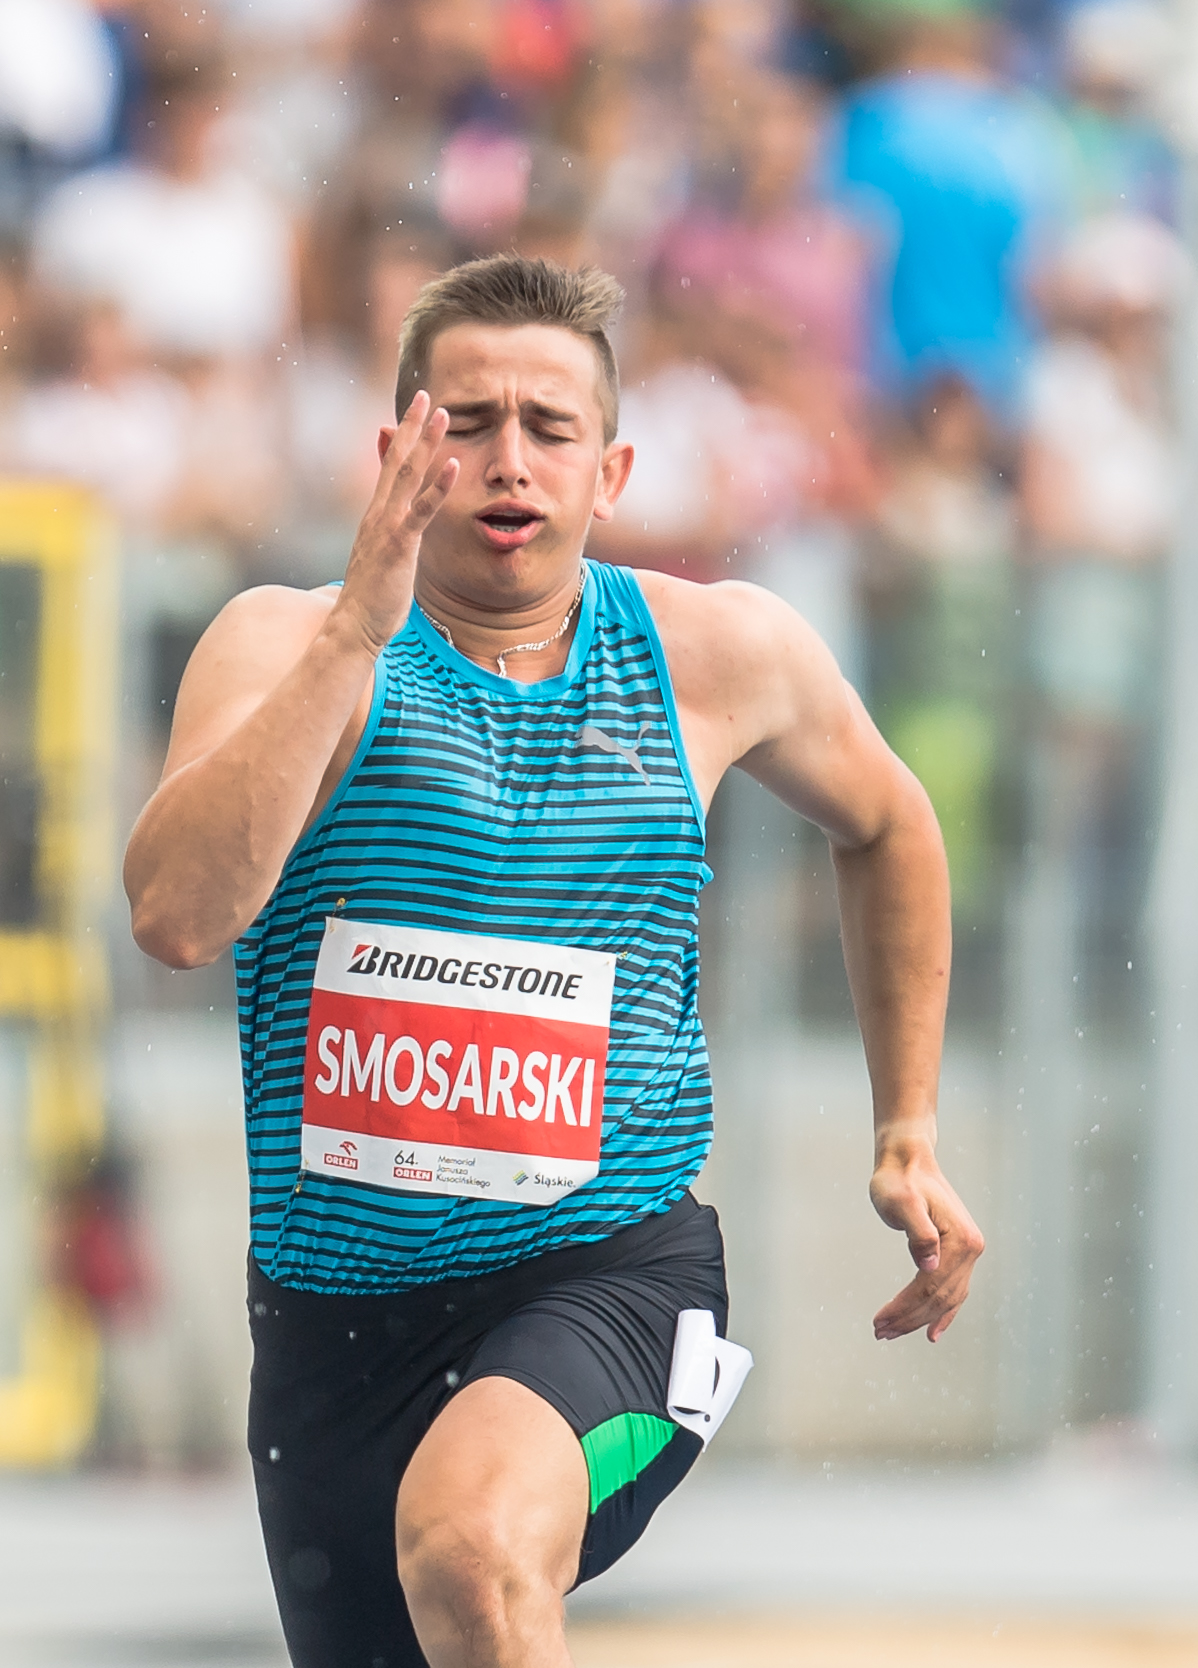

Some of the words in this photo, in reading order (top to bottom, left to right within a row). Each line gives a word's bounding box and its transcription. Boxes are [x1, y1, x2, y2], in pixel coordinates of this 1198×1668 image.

[346, 943, 583, 999] BRIDGESTONE
[314, 1024, 596, 1128] SMOSARSKI
[325, 1154, 357, 1168] ORLEN
[394, 1168, 432, 1181] ORLEN
